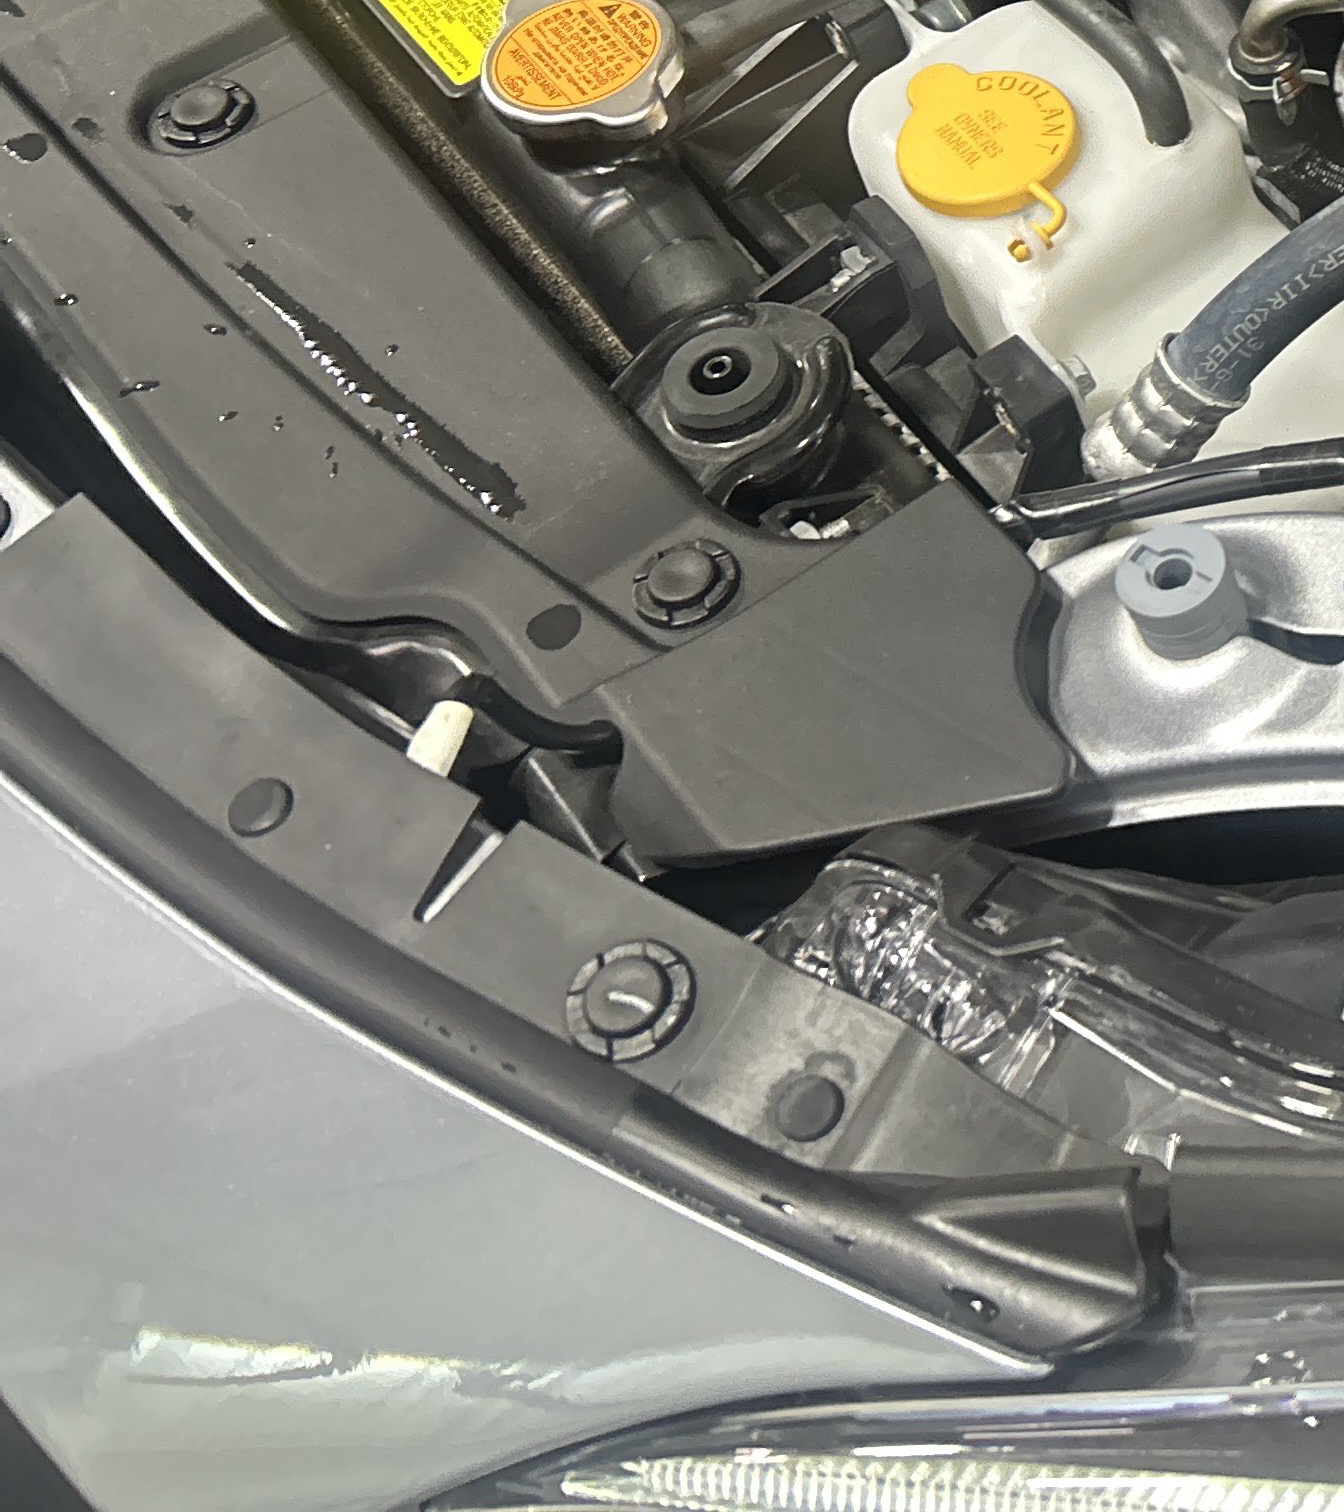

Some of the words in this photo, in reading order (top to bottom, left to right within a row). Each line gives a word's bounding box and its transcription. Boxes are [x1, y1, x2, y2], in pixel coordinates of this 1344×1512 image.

[616, 12, 652, 47] WARNING
[975, 75, 1066, 156] COOLANT
[935, 123, 984, 170] MANUAL
